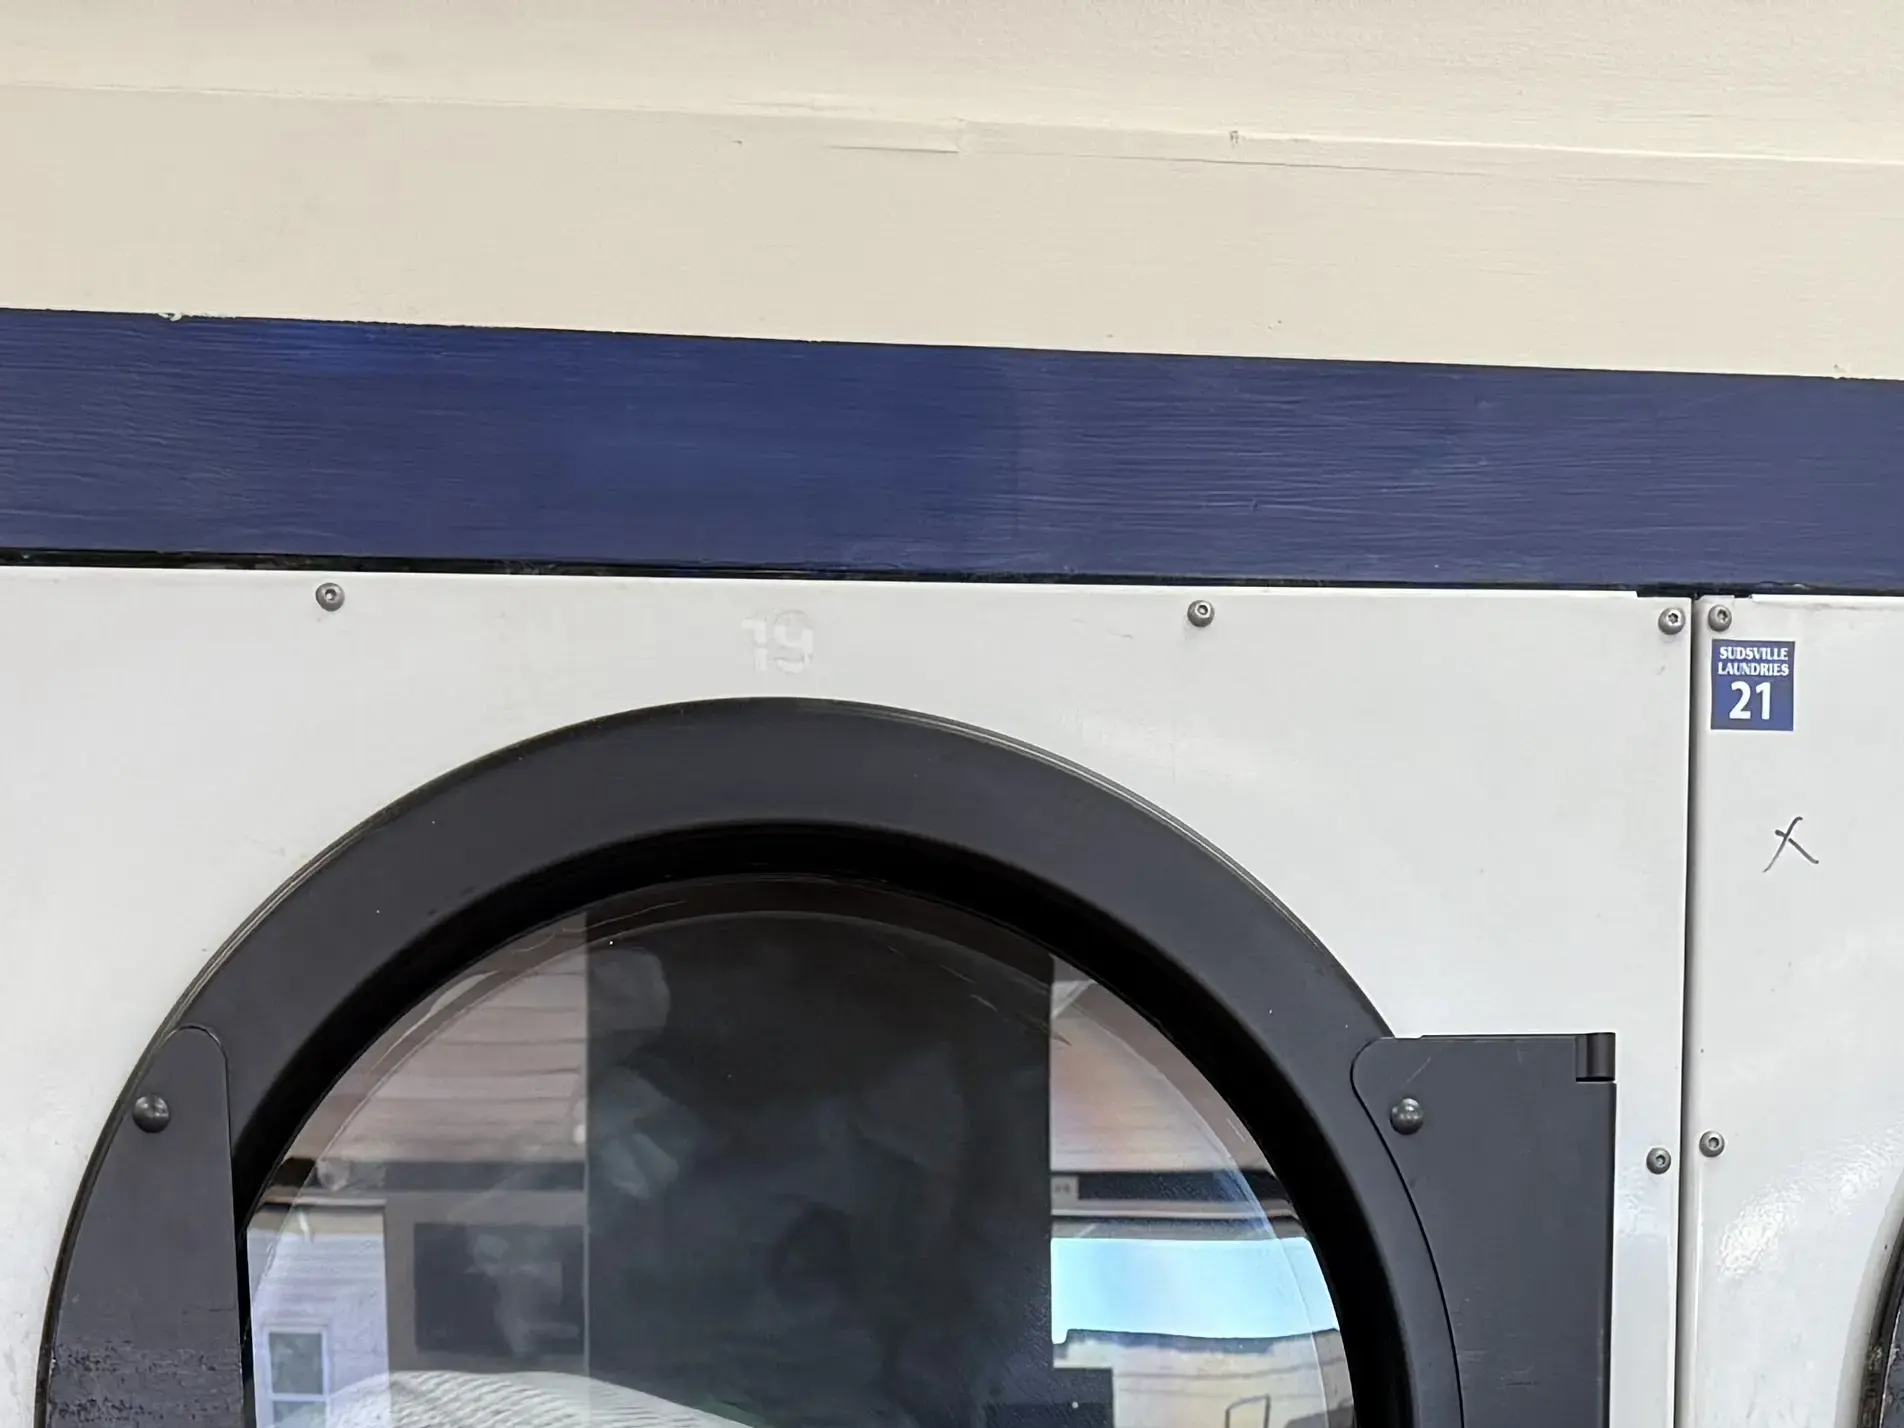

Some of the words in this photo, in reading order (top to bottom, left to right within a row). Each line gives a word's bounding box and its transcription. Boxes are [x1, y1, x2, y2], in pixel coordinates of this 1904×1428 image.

[1719, 646, 1789, 661] SUDSVILLE
[1717, 661, 1790, 677] LAUNDRIES
[1729, 680, 1771, 720] 21
